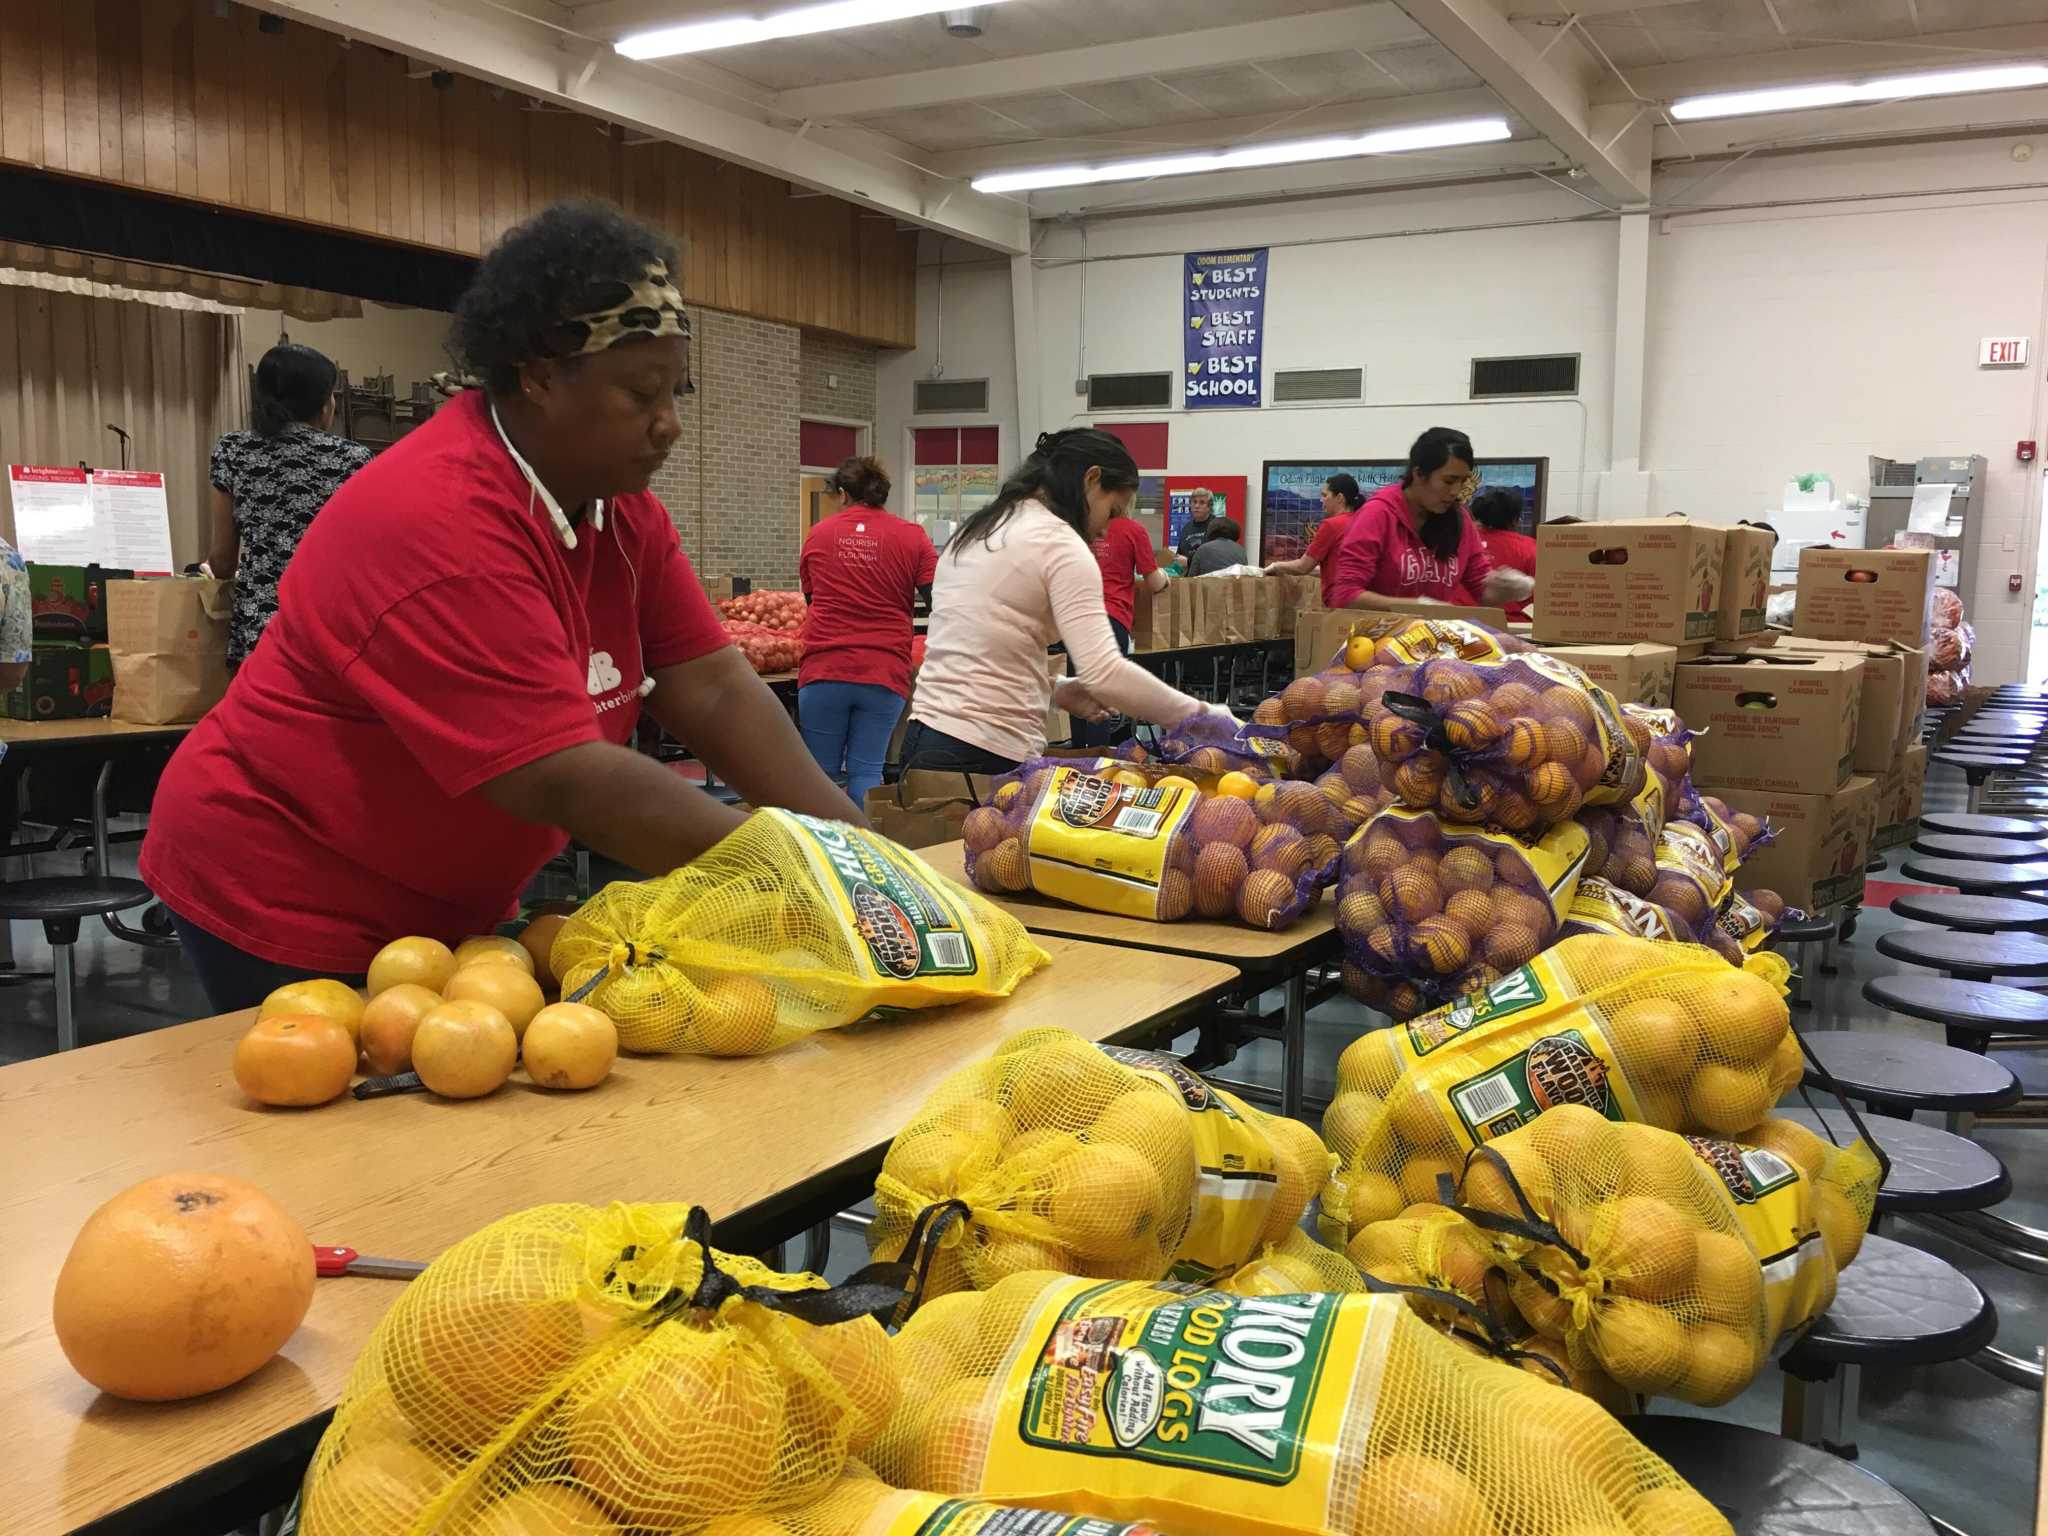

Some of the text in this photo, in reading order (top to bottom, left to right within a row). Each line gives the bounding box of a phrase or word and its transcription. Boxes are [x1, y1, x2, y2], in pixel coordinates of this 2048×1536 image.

[1212, 267, 1257, 283] BEST
[1190, 286, 1260, 301] STUDENTS
[1211, 310, 1254, 326] BEST
[1201, 329, 1256, 346] STAFF
[1990, 341, 2021, 362] EXIT
[1207, 355, 1257, 374] BEST
[1185, 379, 1257, 396] SCHOOL
[838, 537, 878, 548] NOURISH
[838, 550, 878, 561] FLOURISH
[1616, 631, 1649, 640] CANADA
[1072, 776, 1102, 816] WOO
[1530, 1060, 1565, 1106] FLAVO
[1544, 1048, 1588, 1105] WOO
[1197, 1292, 1325, 1460] KORY
[1124, 1359, 1146, 1435] Without Adding
[1140, 1369, 1156, 1424] Add Flavor
[1156, 1348, 1208, 1443] LOGS
